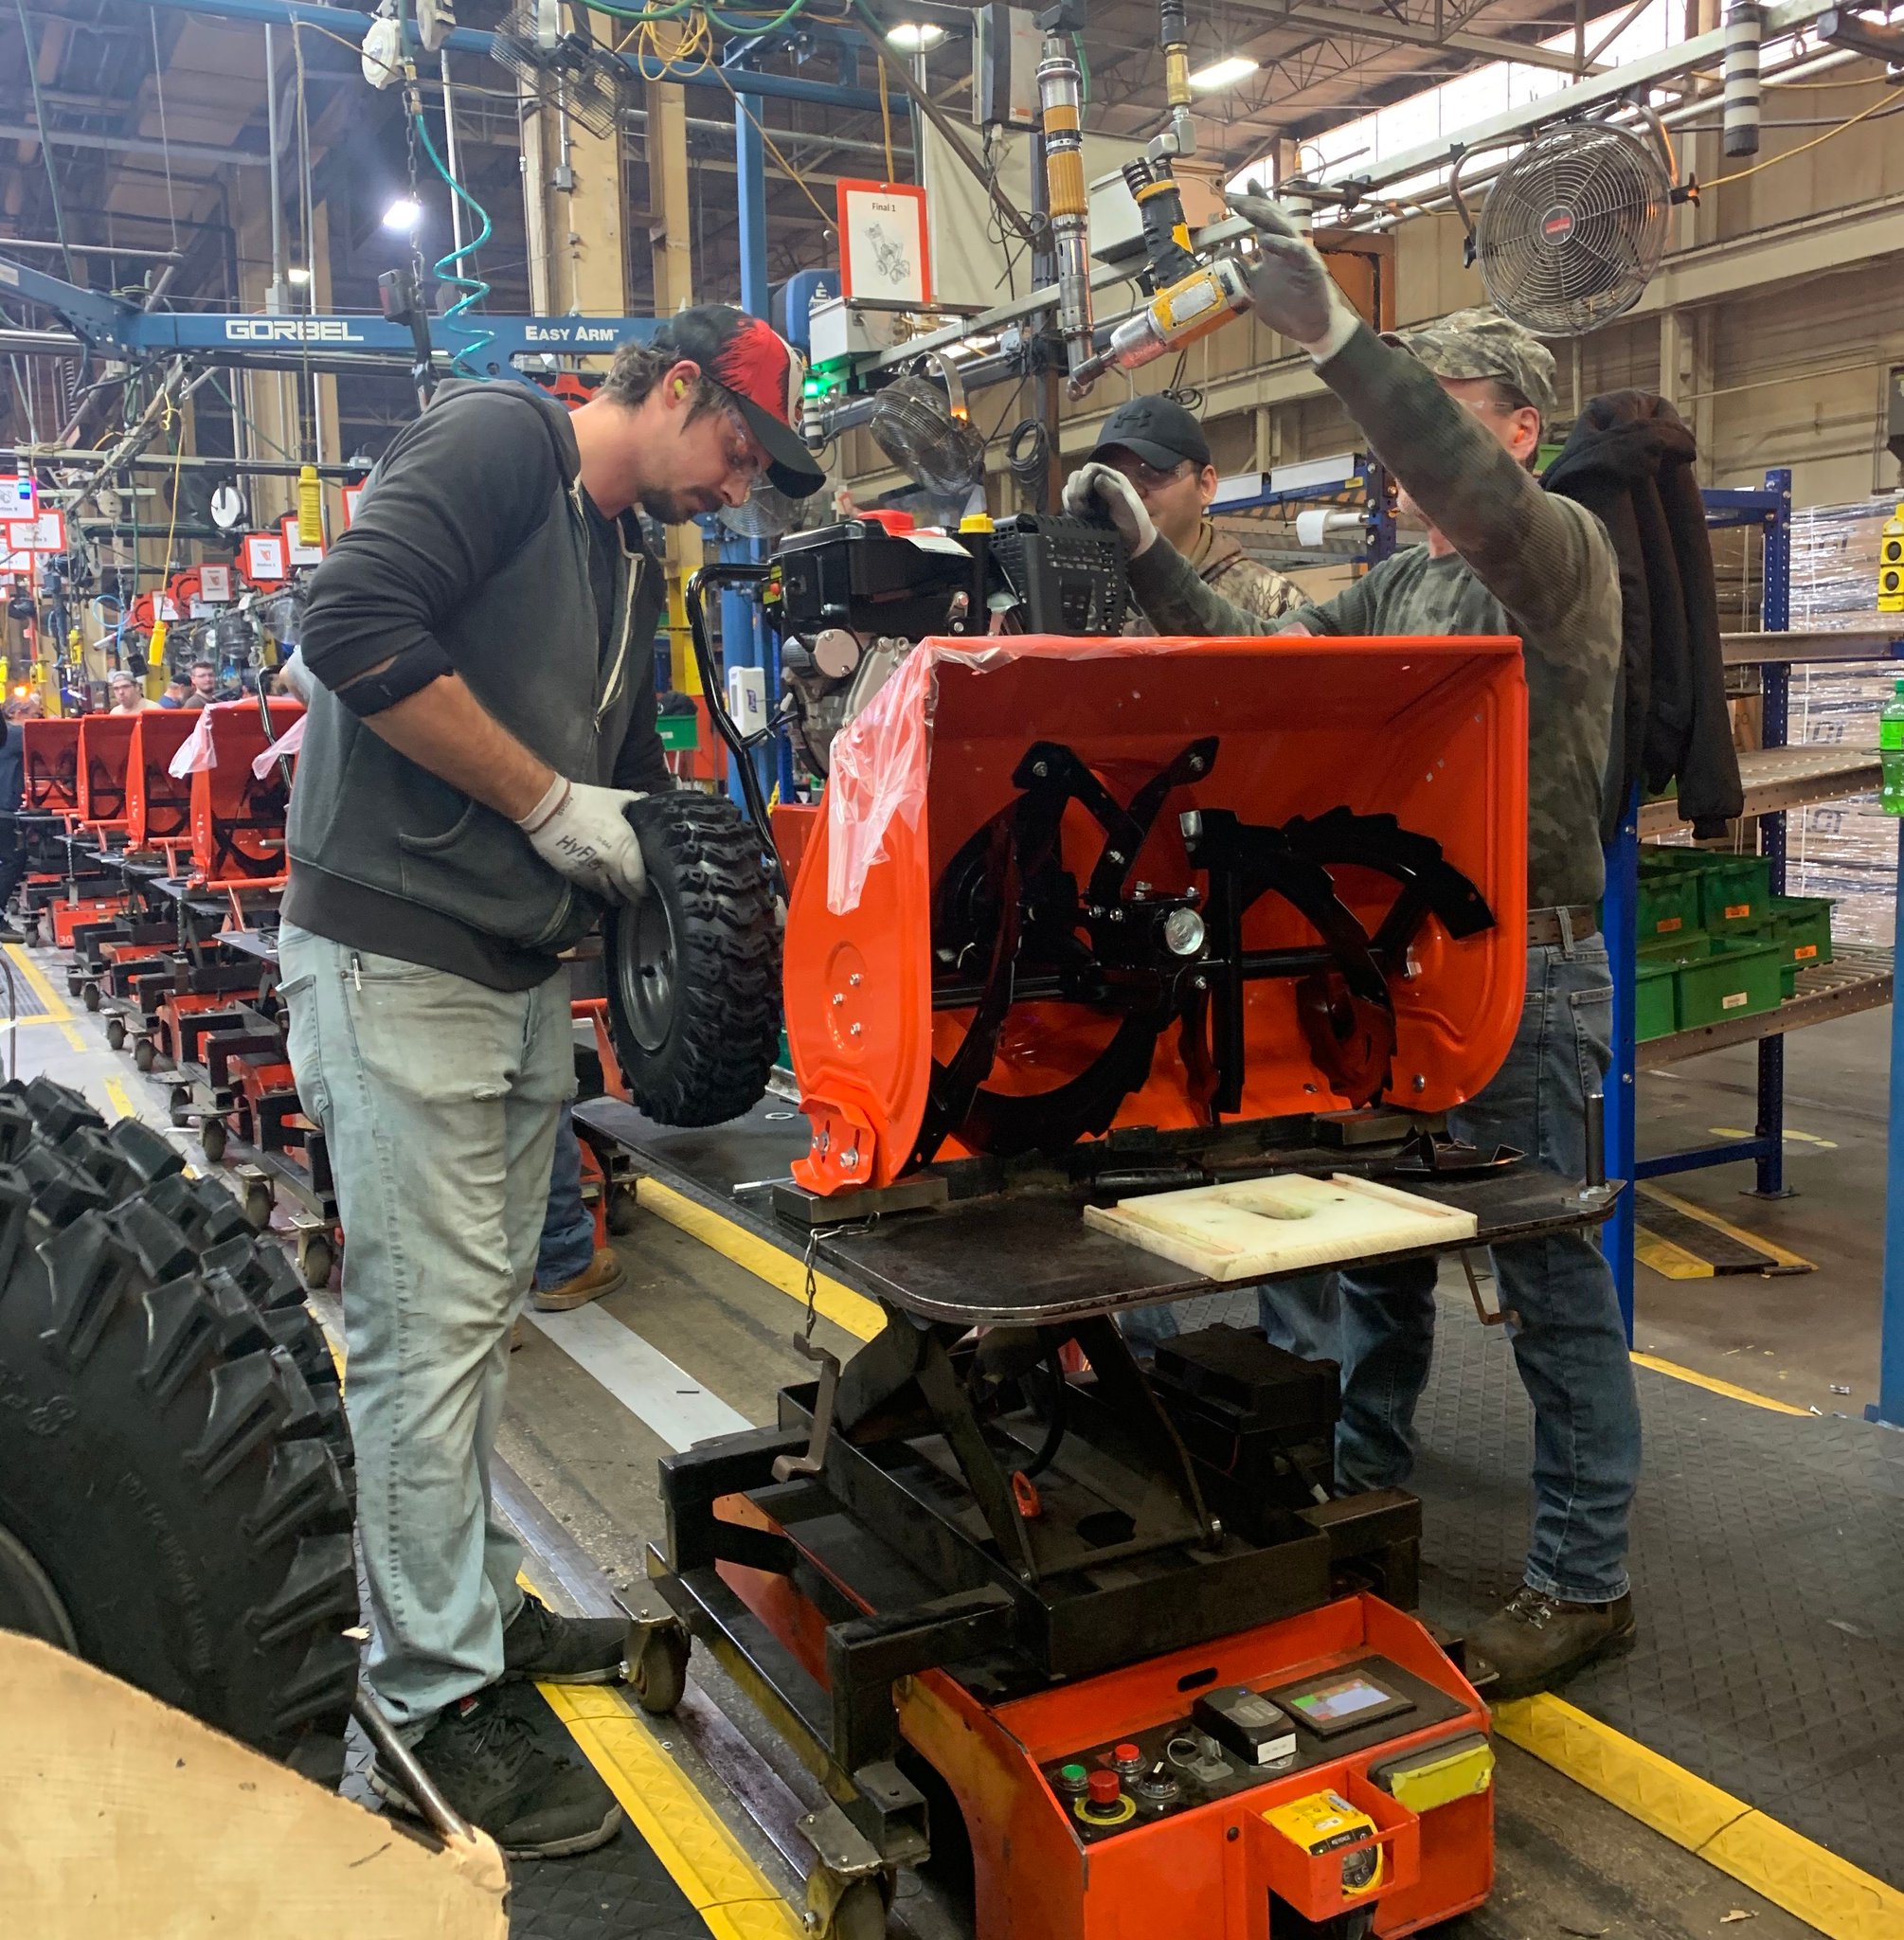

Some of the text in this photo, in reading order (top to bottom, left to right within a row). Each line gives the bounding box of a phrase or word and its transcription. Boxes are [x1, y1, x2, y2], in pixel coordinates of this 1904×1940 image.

[871, 202, 896, 212] Final 1
[225, 319, 365, 342] GORBEL
